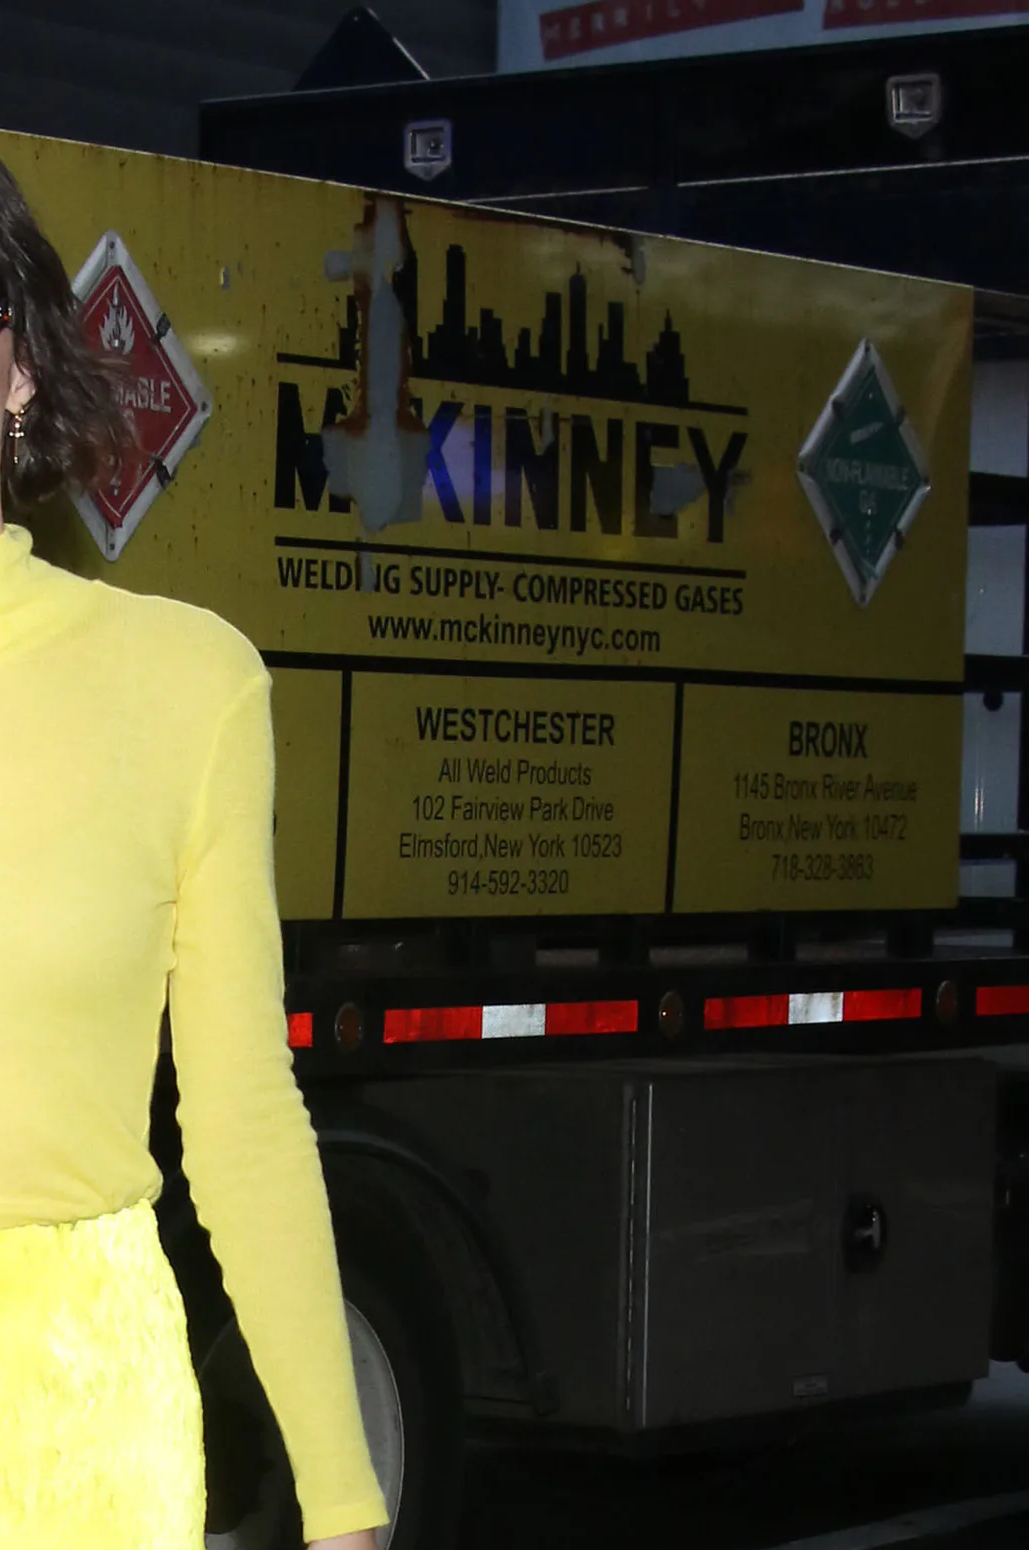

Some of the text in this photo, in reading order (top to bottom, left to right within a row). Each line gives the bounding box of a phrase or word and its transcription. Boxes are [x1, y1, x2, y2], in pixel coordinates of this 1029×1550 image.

[512, 571, 668, 611] COMPRESSED
[674, 583, 745, 616] GASES
[367, 612, 662, 656] www.mckinneynyc.com
[416, 706, 616, 746] WESTCHESTER
[788, 720, 869, 759] BRONX
[438, 757, 593, 787] All Weld Products
[733, 772, 918, 804] 1145 Bronx River Avenue
[412, 795, 615, 823] 102 Fairview Park Drive
[826, 813, 859, 842] York
[864, 814, 908, 843] 10472
[528, 833, 566, 860] York
[571, 833, 623, 860] 10523
[448, 869, 570, 897] 914-592-3320
